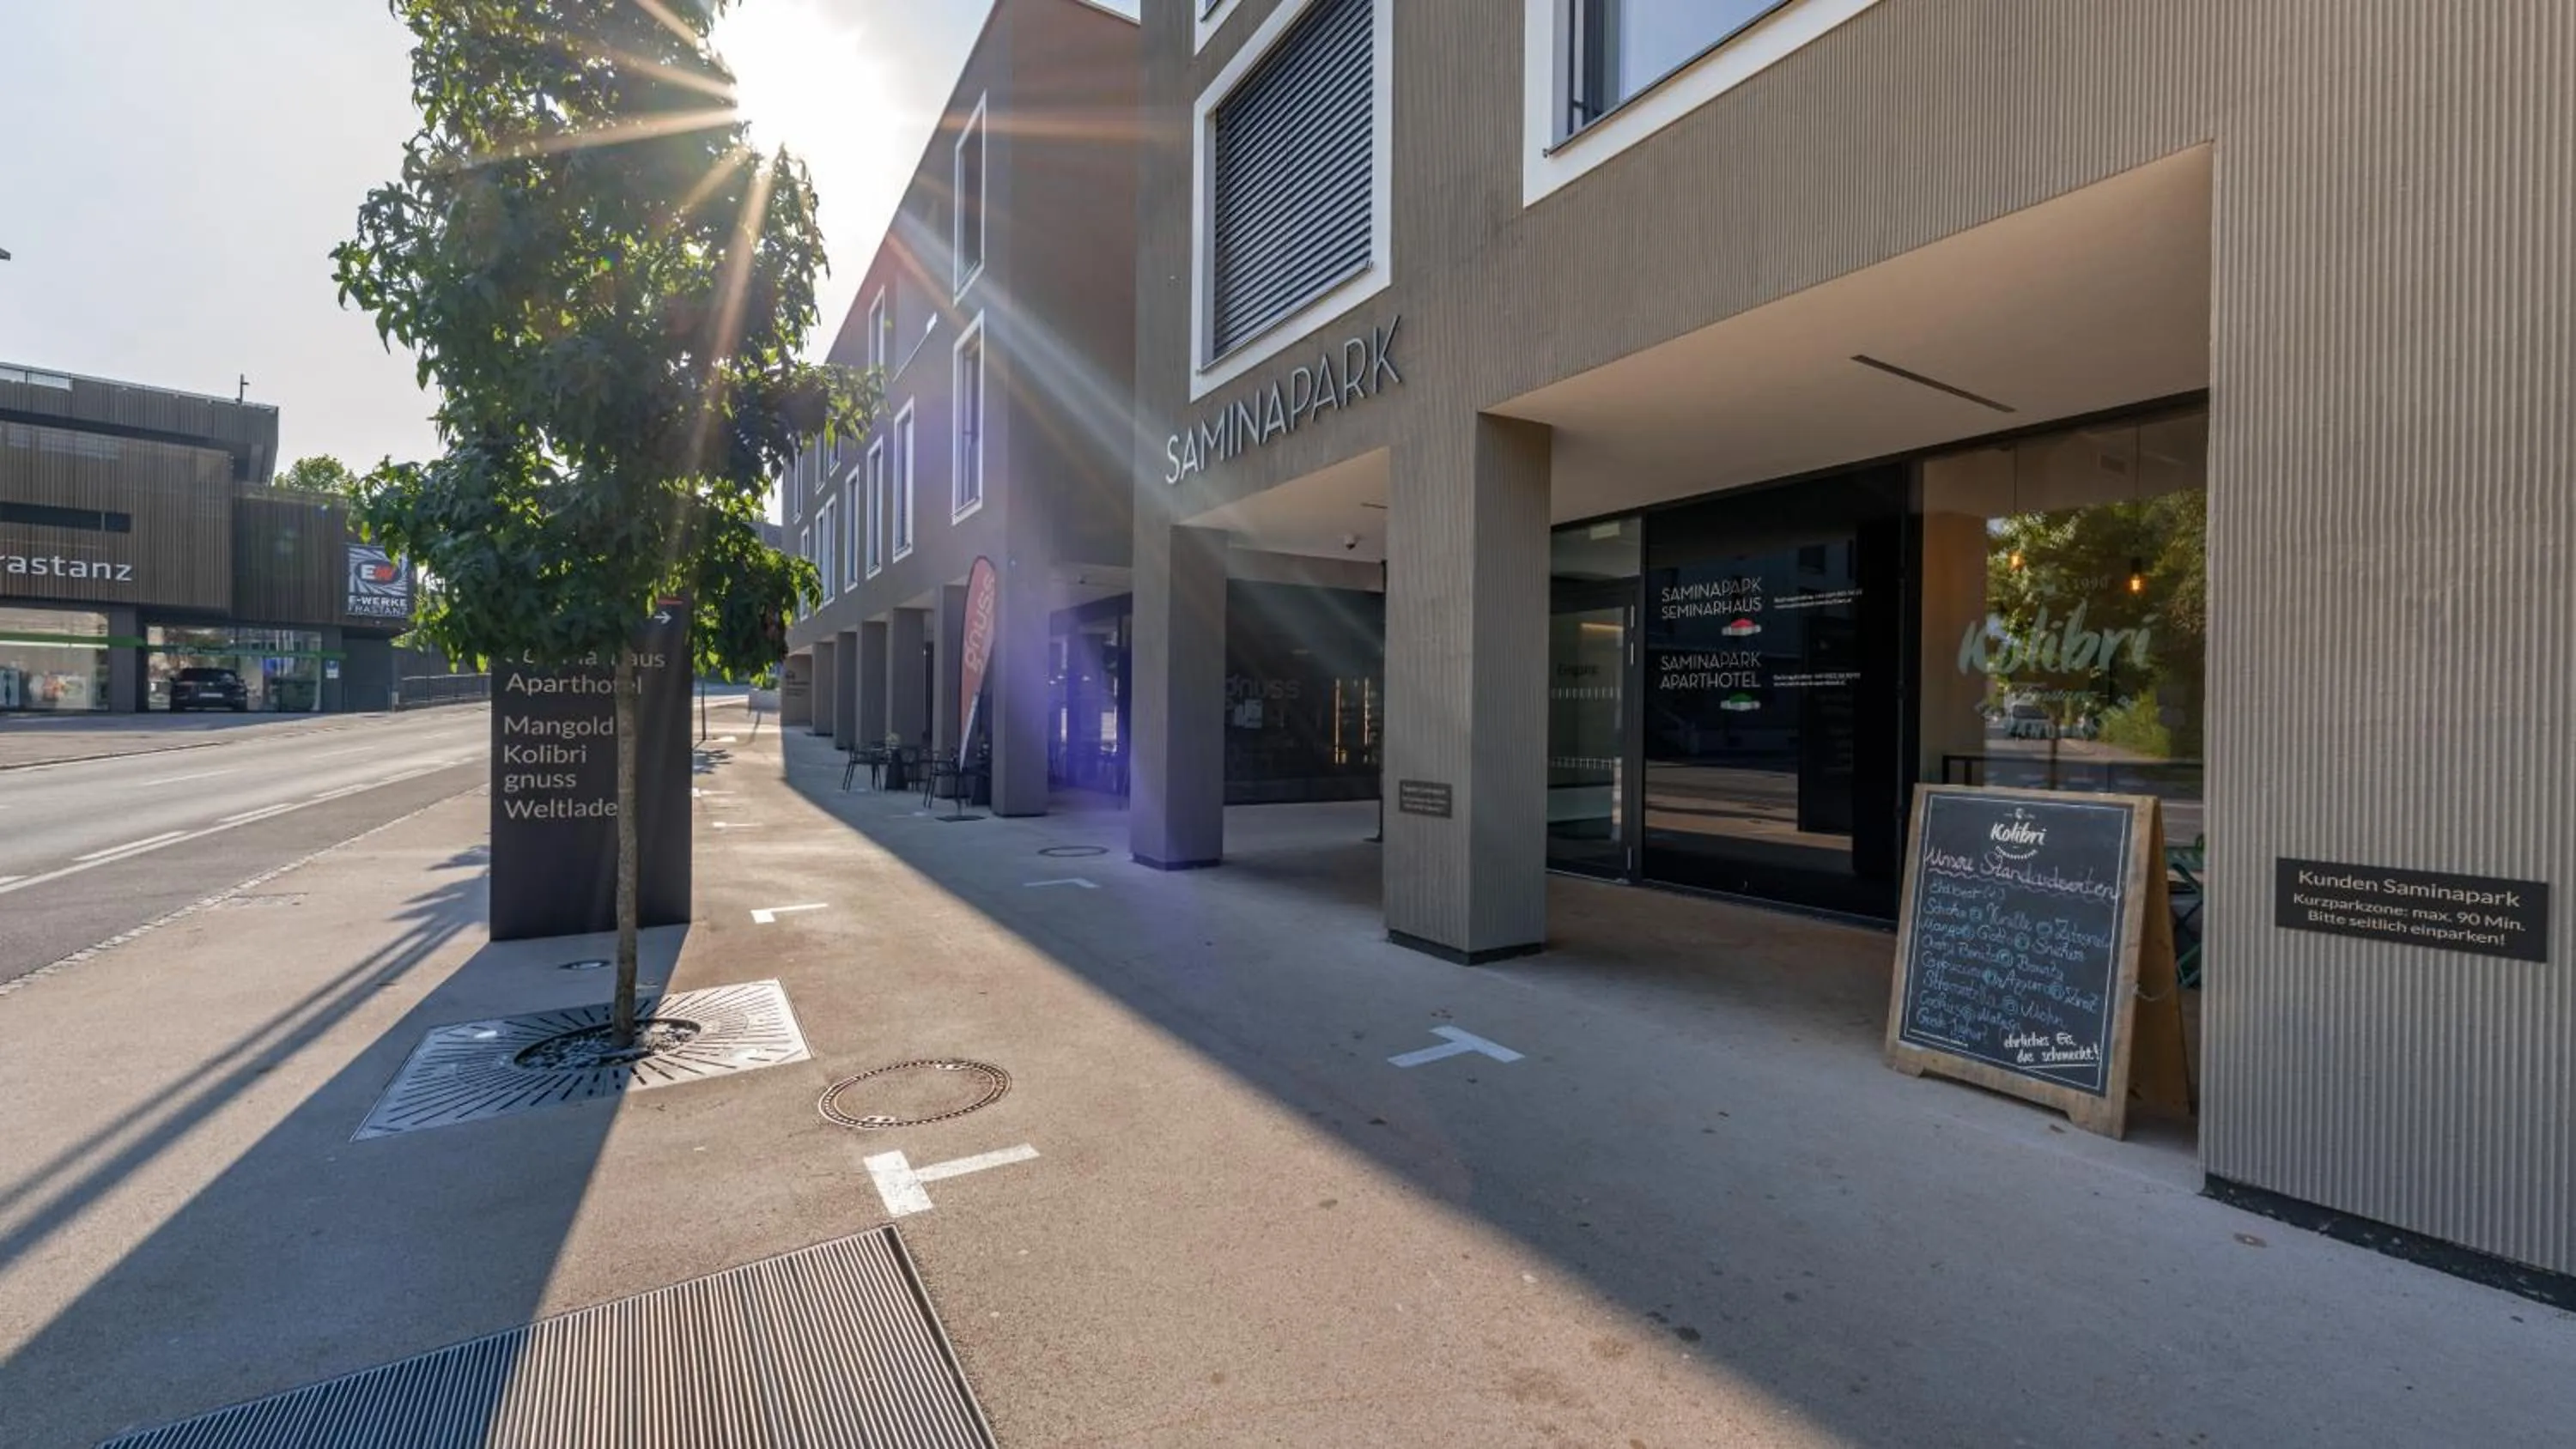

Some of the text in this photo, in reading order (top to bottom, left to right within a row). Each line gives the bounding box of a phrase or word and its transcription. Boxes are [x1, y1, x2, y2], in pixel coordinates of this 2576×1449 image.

[1165, 314, 1402, 485] SAMINAPARK
[348, 595, 408, 607] E-WERKE
[1662, 577, 1762, 603] SAMINAPARK
[1662, 597, 1762, 620] SEMINARHAUS
[1958, 598, 2160, 676] Kolibri
[1661, 652, 1761, 671] SAMINAPARK
[505, 672, 642, 696] Aparthol
[1661, 671, 1760, 690] APARTHOTEL
[503, 715, 614, 739] Mangold
[503, 744, 587, 764] Kolibri
[503, 773, 578, 793] gnuss
[503, 798, 619, 819] Weltlade
[1990, 820, 2049, 845] Kolibri
[2298, 870, 2521, 908] Kunden Saminapark
[2293, 893, 2526, 933] Kurzparkzone: max. 90 Min.
[2307, 909, 2506, 946] Bitte seitlich einparken!
